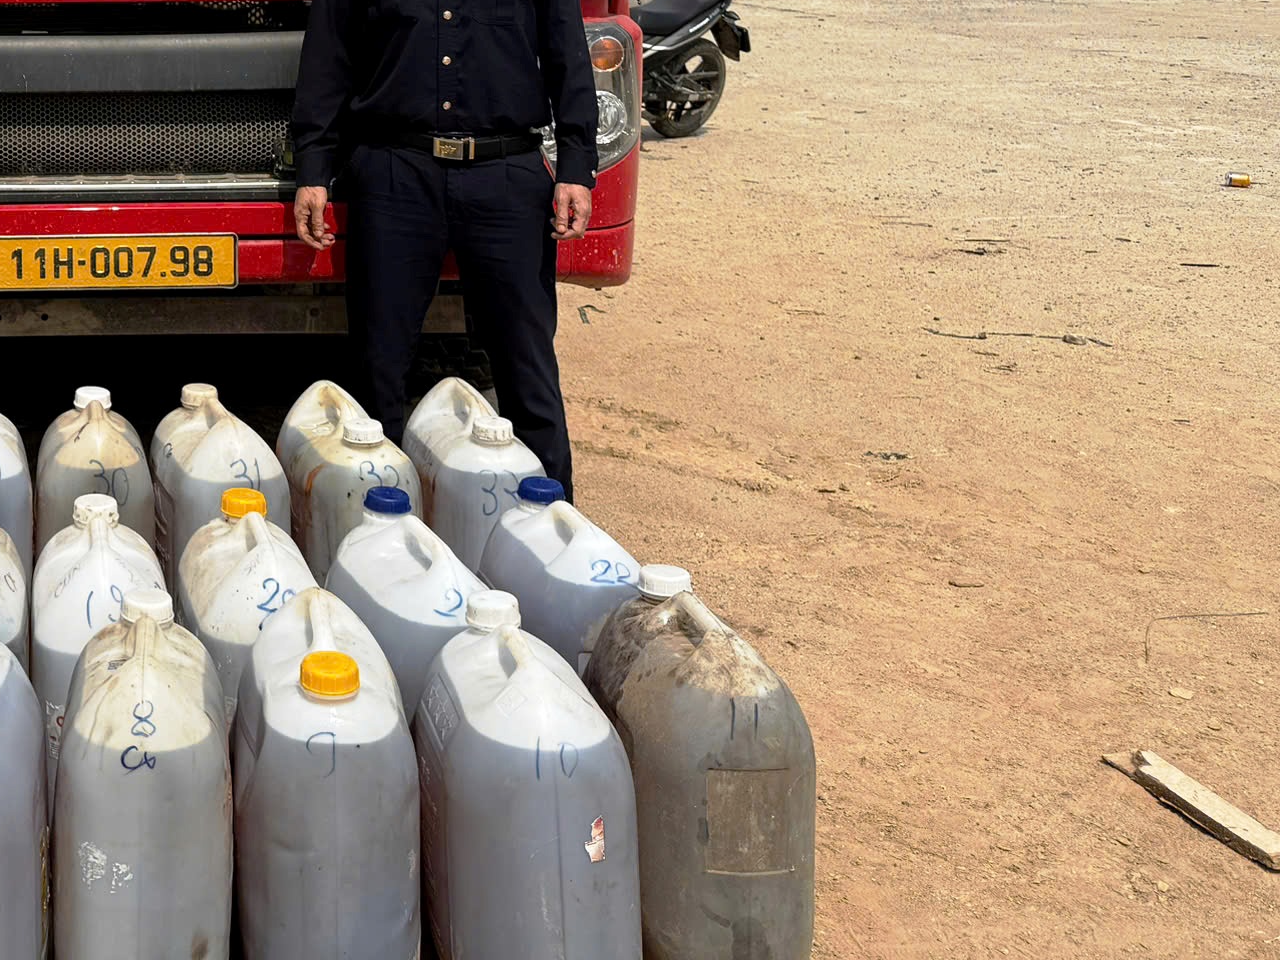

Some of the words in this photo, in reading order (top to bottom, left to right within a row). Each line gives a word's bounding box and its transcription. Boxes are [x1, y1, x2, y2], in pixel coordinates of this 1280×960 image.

[11, 245, 214, 280] 11H-007.98
[89, 459, 129, 506] 30
[590, 560, 638, 586] 22
[131, 700, 157, 738] 8
[729, 697, 759, 741] 11
[536, 736, 579, 781] 10
